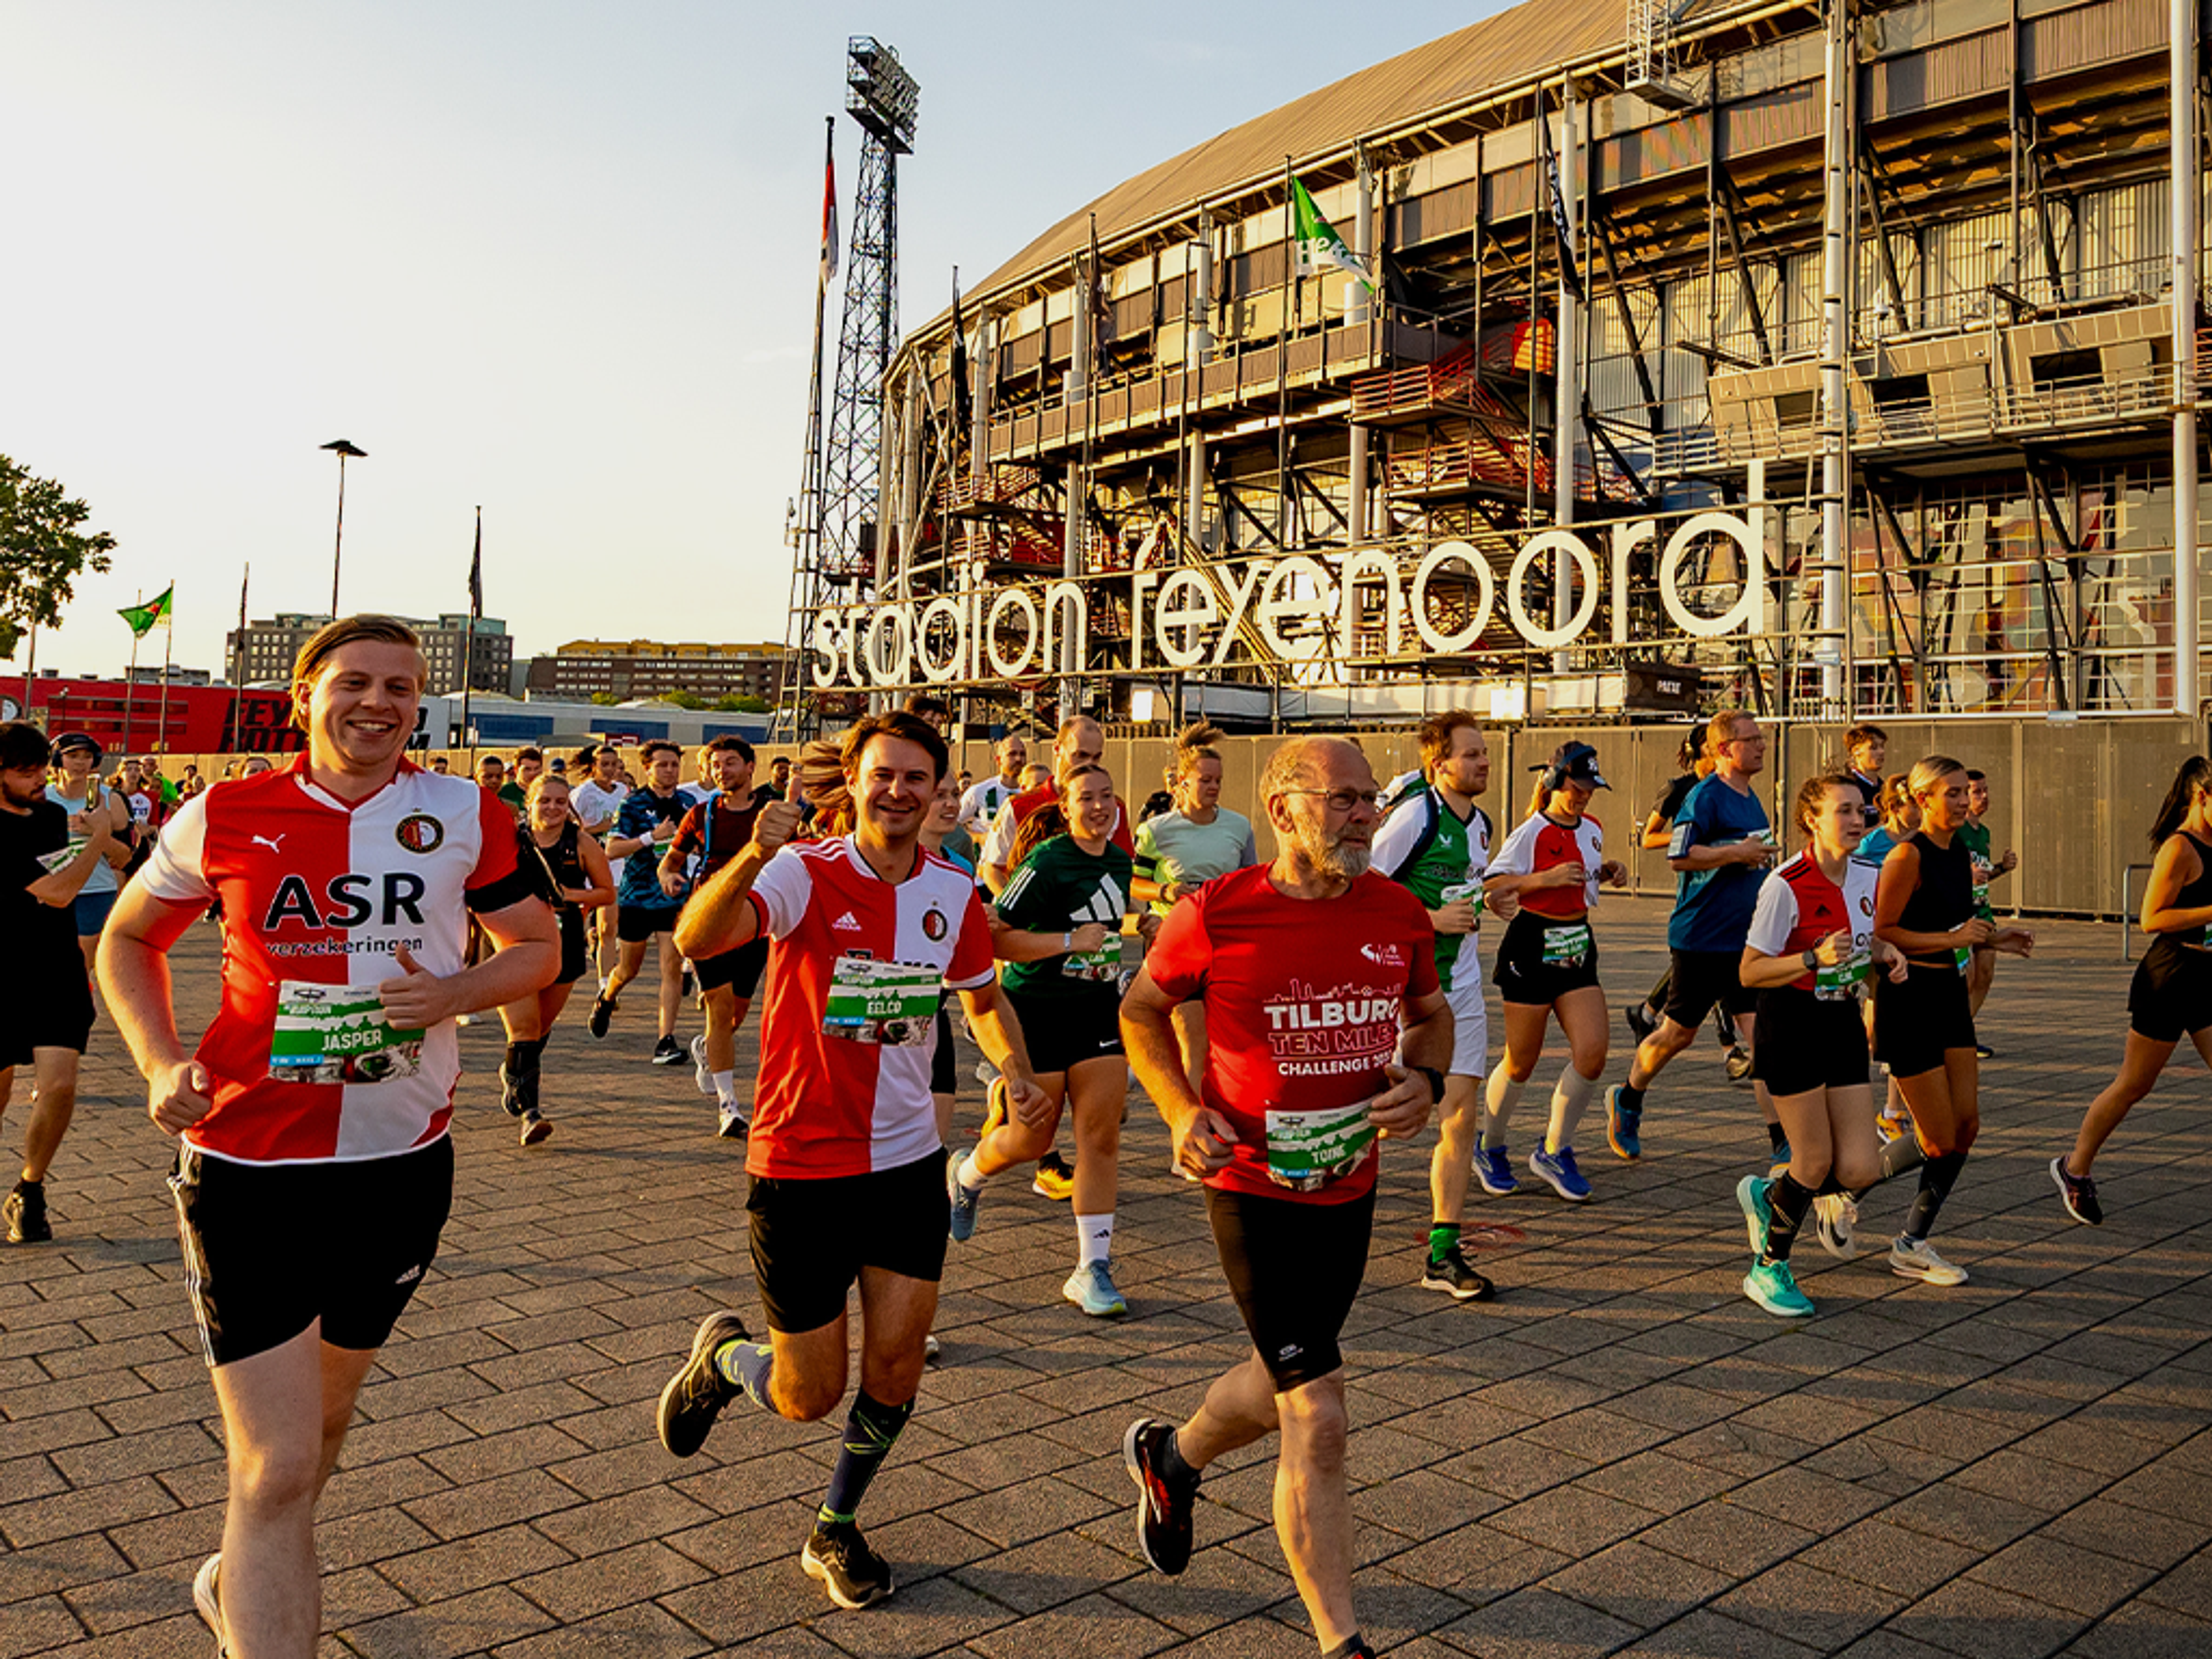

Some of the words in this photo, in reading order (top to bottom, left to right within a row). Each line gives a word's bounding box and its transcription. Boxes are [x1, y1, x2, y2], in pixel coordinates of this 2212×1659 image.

[812, 561, 1087, 688] stadion
[1131, 461, 1764, 671] feyenoord
[263, 873, 426, 931] ASR
[266, 935, 423, 956] verzekeringen
[321, 1028, 382, 1052] JASPER
[1268, 1030, 1330, 1055] TEN
[1334, 1023, 1395, 1053] MILE
[1278, 1057, 1370, 1076] CHALLENGE
